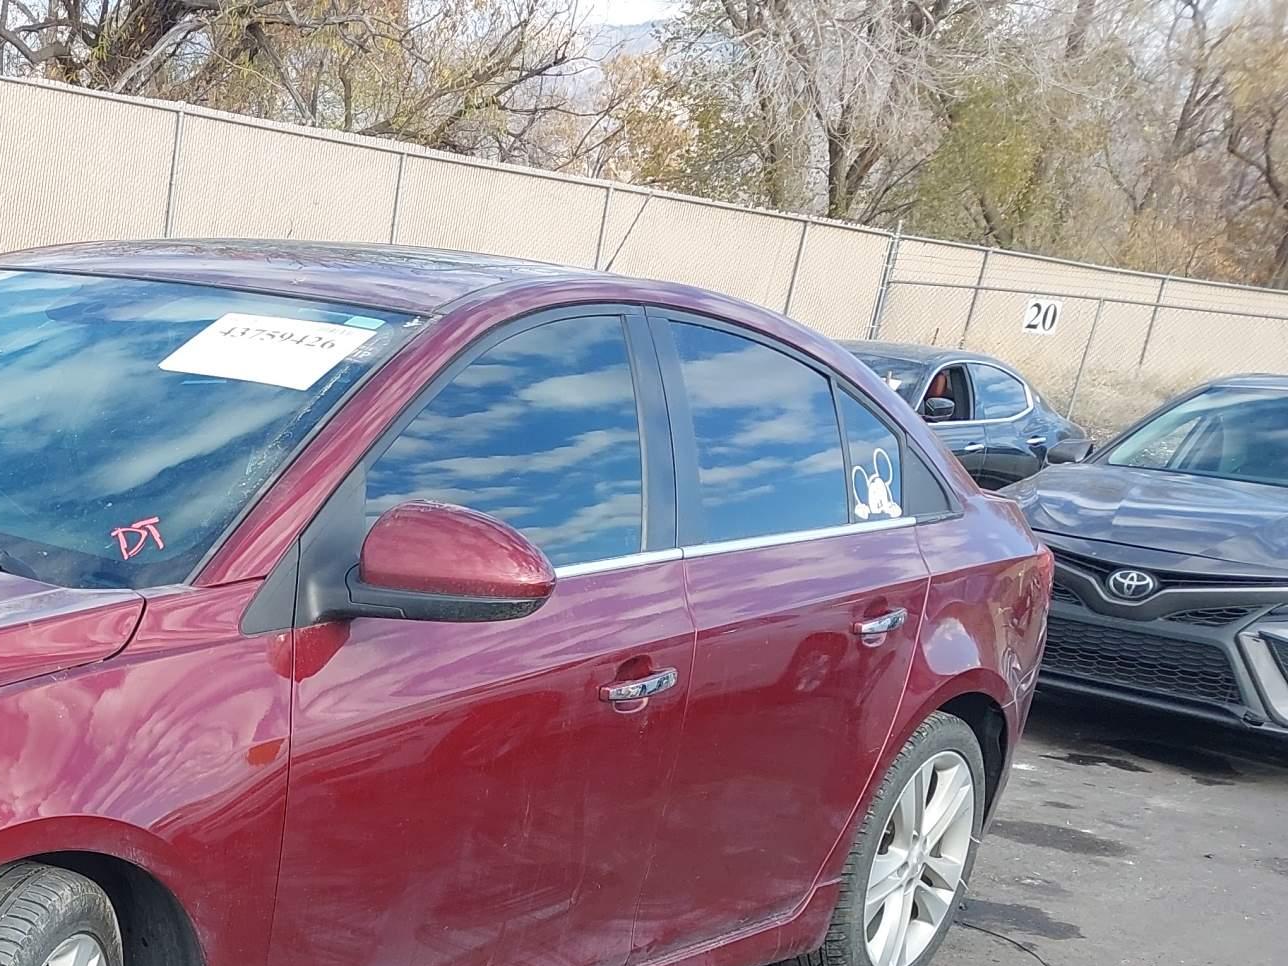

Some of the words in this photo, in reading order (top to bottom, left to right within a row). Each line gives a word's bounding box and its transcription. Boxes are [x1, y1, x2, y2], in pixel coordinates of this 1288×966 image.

[1025, 302, 1058, 332] 20
[219, 326, 337, 350] 43759426
[111, 516, 164, 560] DT
